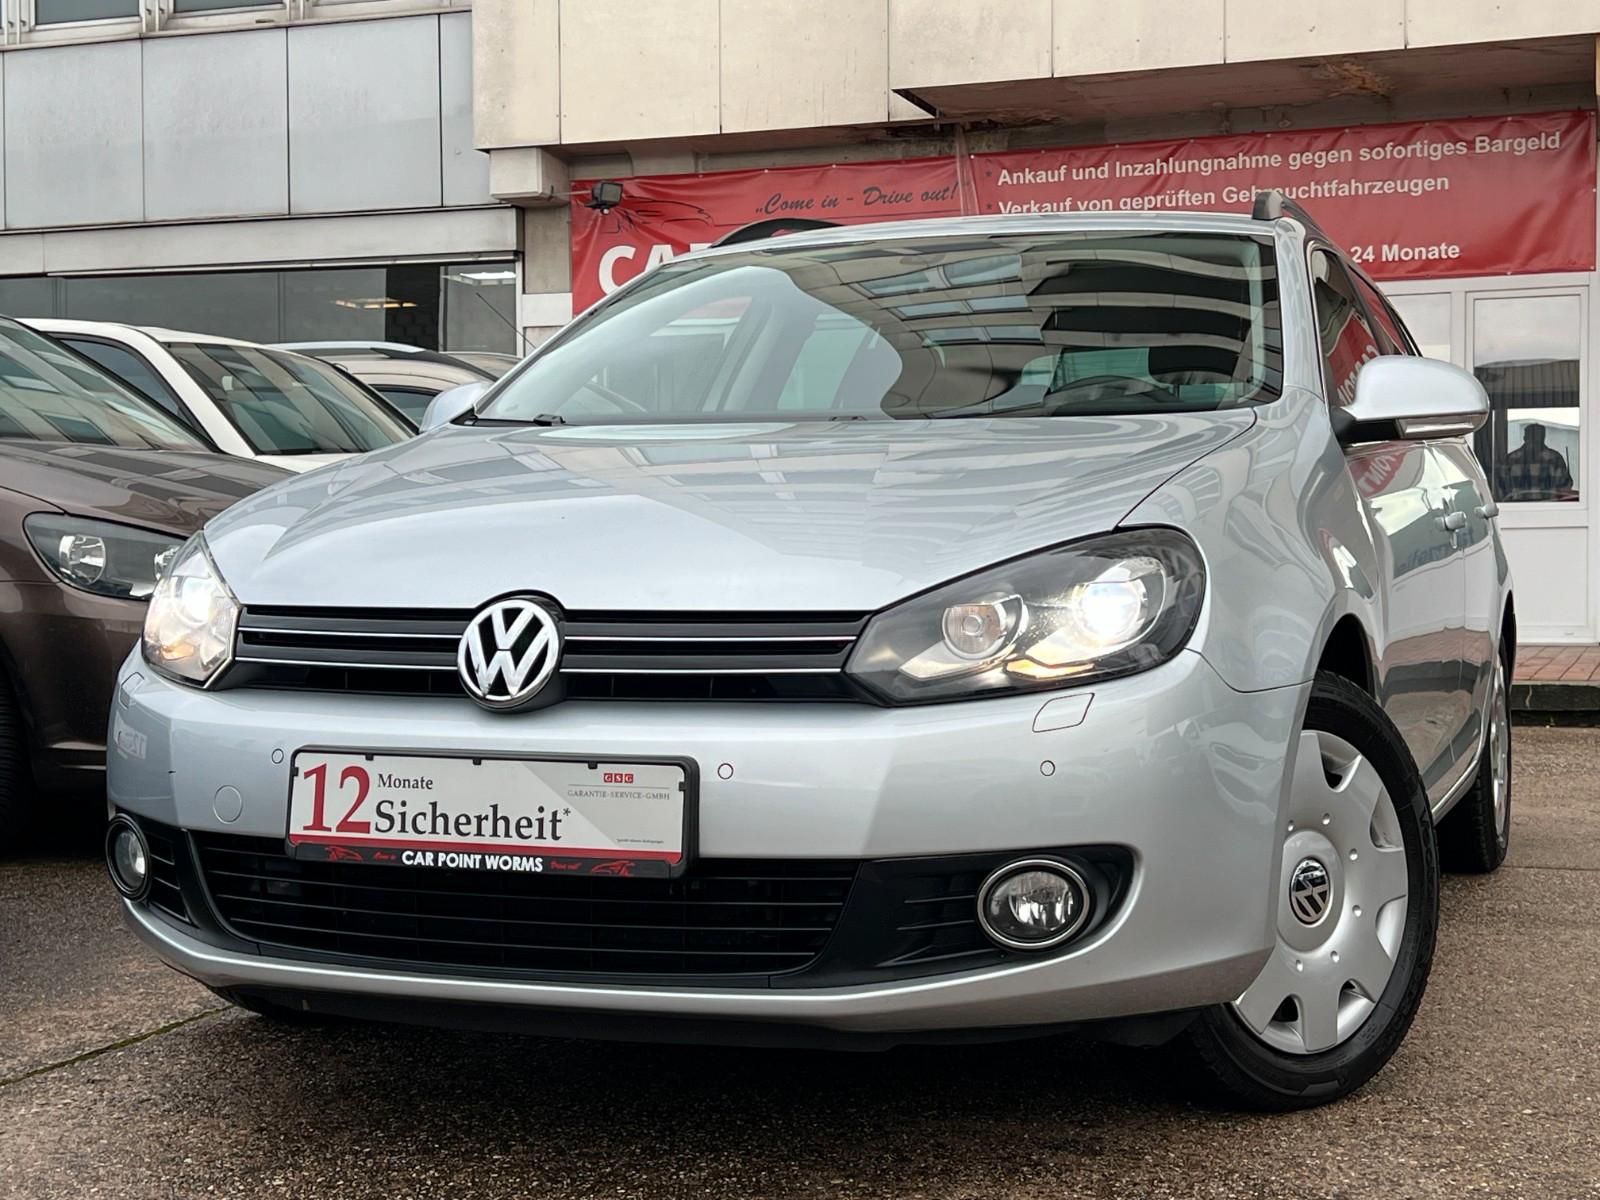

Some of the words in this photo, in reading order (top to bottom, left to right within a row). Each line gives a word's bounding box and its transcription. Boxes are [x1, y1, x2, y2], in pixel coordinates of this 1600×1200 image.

[998, 164, 1068, 185] Ankauf
[1072, 159, 1109, 181] und
[1115, 152, 1282, 178] Inzahlungnahme
[1288, 147, 1352, 170] gegen
[1359, 138, 1468, 162] sofortiges
[1475, 131, 1561, 155] Bargeld
[821, 194, 839, 208] in
[863, 185, 913, 206] Drive
[920, 181, 959, 202] out!
[998, 197, 1073, 214] Verkauf
[1077, 199, 1113, 213] von
[1119, 188, 1216, 210] geprüften
[1350, 245, 1375, 263] 24
[1382, 242, 1460, 262] Monate
[377, 773, 433, 790] Monate
[603, 773, 634, 783] GSG
[302, 763, 371, 834] 12
[401, 850, 434, 866] CAR
[438, 852, 482, 869] POINT
[485, 855, 543, 872] WORMS
